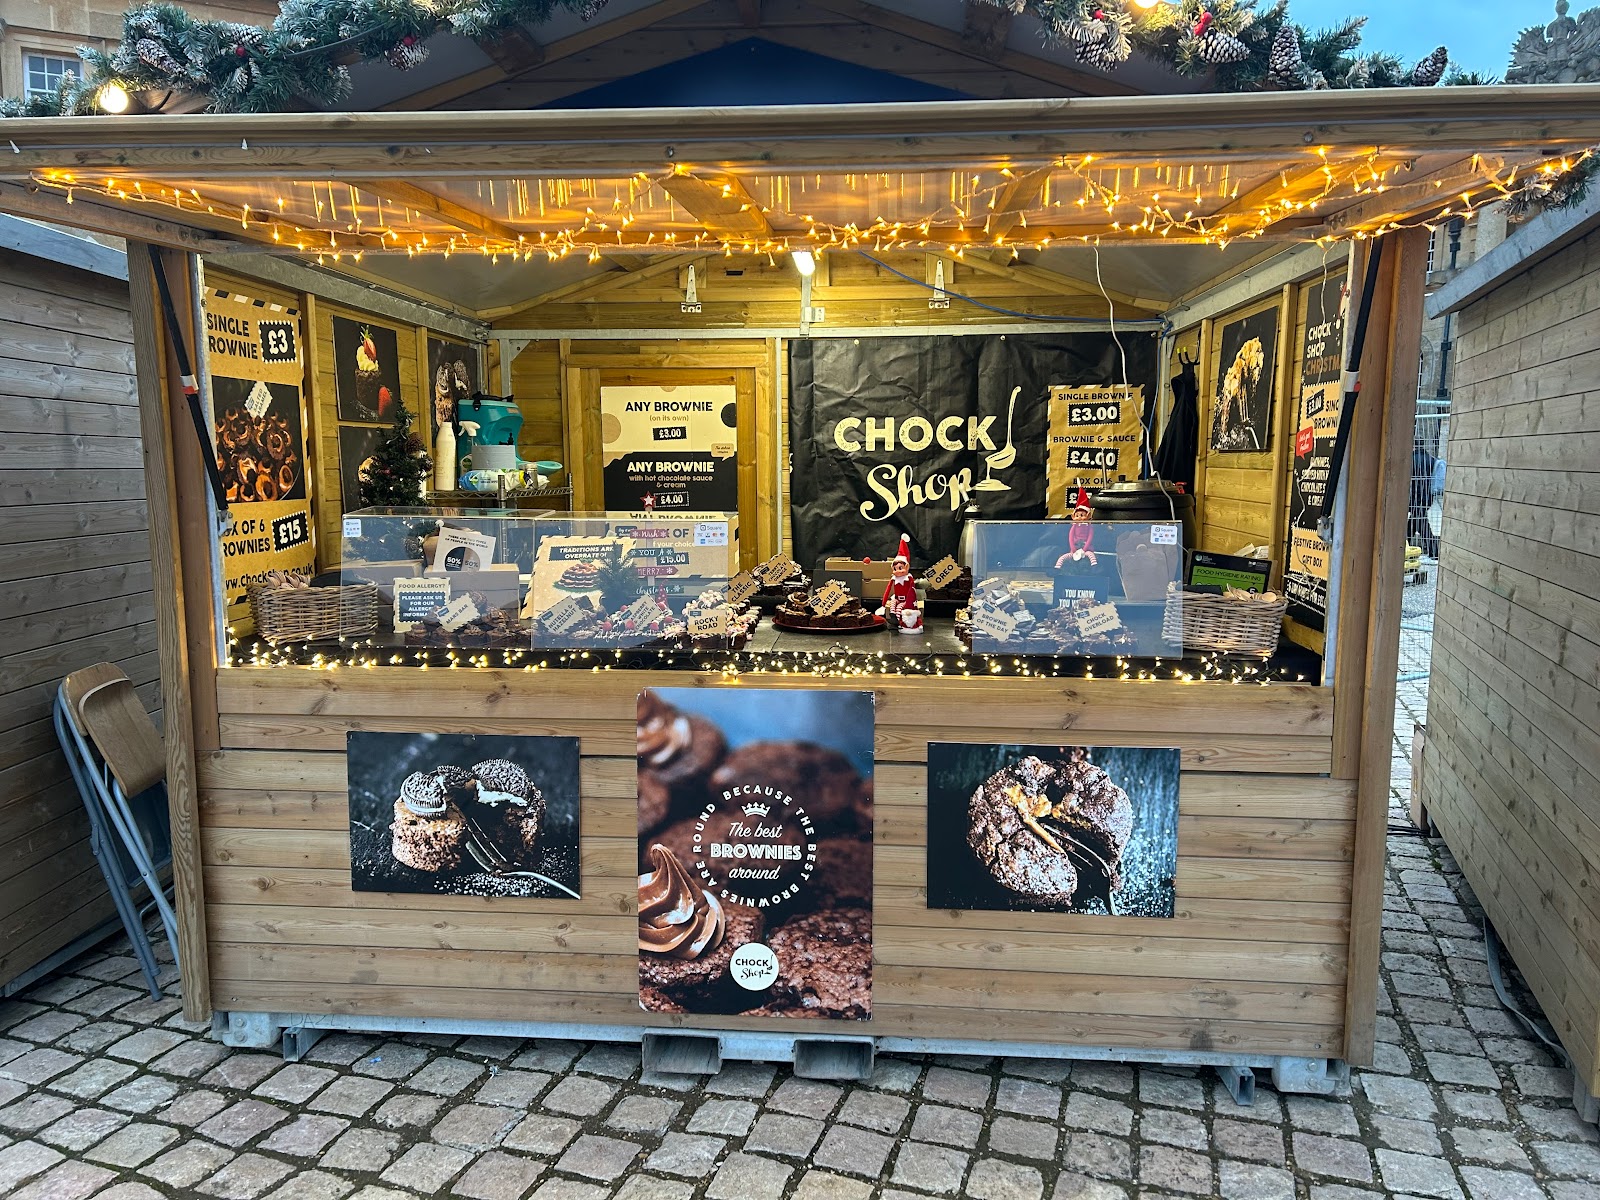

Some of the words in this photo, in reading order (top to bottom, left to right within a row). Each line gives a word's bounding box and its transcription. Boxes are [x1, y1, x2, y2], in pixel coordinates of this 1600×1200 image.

[206, 313, 250, 337] SINGLE
[1308, 321, 1332, 341] CHOCK
[208, 335, 258, 360] ROWNIE
[268, 329, 288, 355] £3
[1306, 341, 1326, 359] SHOP
[625, 401, 651, 412] ANY
[654, 401, 713, 412] BROWNIE
[1071, 406, 1118, 422] £3.00
[659, 428, 682, 439] £3.00
[833, 415, 997, 452] CHOCK
[1070, 450, 1116, 466] £4.00
[626, 461, 653, 473] ANY
[655, 461, 715, 473] BROWNIE
[660, 495, 683, 505] £4.00
[859, 463, 973, 522] Shop
[241, 520, 256, 535] OF
[259, 519, 265, 532] 6
[279, 519, 301, 544] £15
[672, 528, 690, 538] OF
[223, 537, 270, 557] ROWNIES
[447, 556, 461, 565] 50%
[464, 560, 478, 568] 50%
[1313, 555, 1323, 568] BOX
[935, 564, 954, 583] OREO
[1214, 570, 1239, 579] HYGIENE
[731, 581, 752, 602] CLASSIC
[732, 581, 742, 593] THE
[1065, 589, 1077, 598] YOU
[1077, 589, 1096, 599] KNOW
[820, 591, 836, 608] SALTED
[822, 593, 843, 614] CARAMEL
[1059, 598, 1070, 608] YOU
[445, 612, 459, 624] MARS
[458, 603, 469, 613] BAR
[548, 609, 569, 629] NUTELLA
[553, 607, 577, 632] HAZELNUT
[694, 615, 719, 626] ROCKY
[981, 613, 1007, 627] BROWNIE
[1086, 612, 1106, 625] CHOCK
[697, 622, 718, 631] ROAD
[985, 621, 996, 629] THE
[996, 626, 1008, 634] DAY
[1084, 615, 1114, 632] OVERLOAD
[722, 784, 793, 806] BECAUSE
[692, 803, 716, 853] ROUND
[795, 806, 815, 836] THE
[728, 822, 752, 837] The
[753, 822, 783, 838] best
[710, 842, 802, 860] BROWNIES
[800, 843, 817, 881] BEST
[695, 860, 718, 887] ARE
[728, 864, 781, 880] around
[720, 883, 800, 908] BROWNIES
[735, 958, 769, 967] CHOCK
[740, 967, 764, 980] Shop
